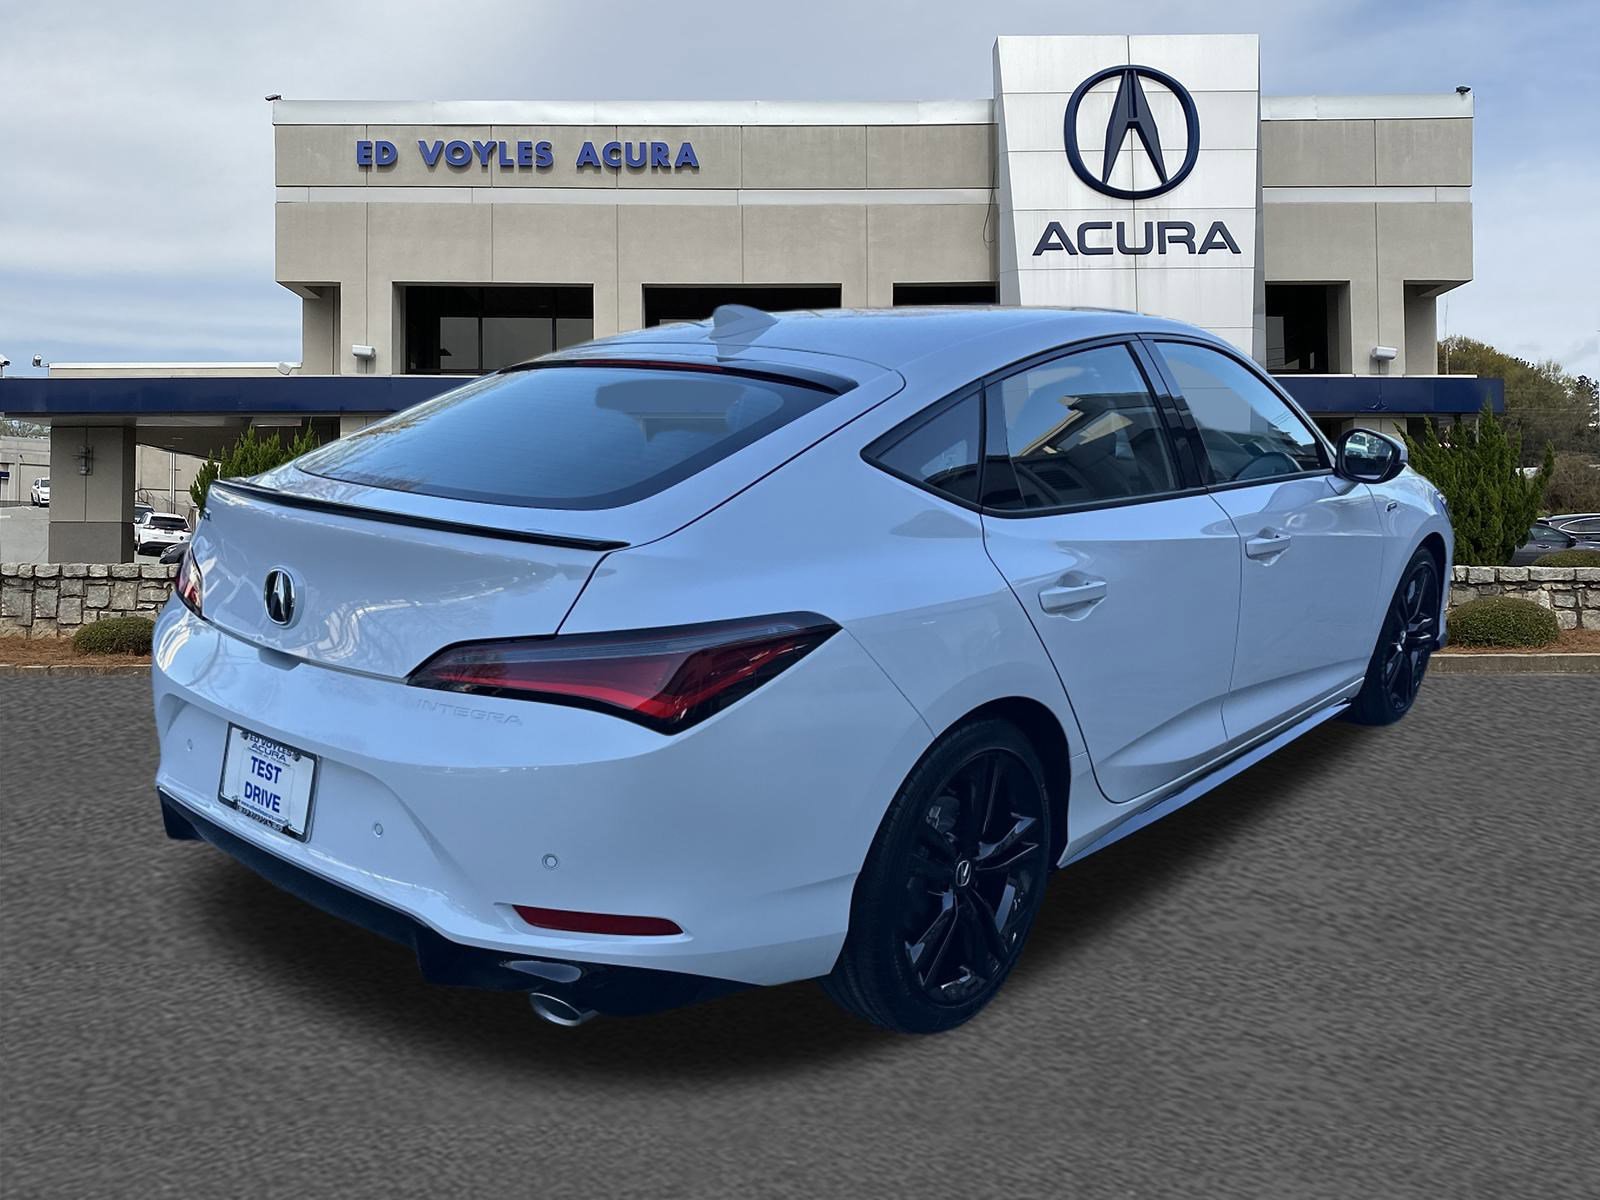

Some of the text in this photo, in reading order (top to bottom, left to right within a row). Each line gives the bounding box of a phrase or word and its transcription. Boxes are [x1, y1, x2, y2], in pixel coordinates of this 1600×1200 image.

[357, 140, 700, 169] ED VOYLES ACURA
[1032, 221, 1242, 256] ACURA
[416, 698, 522, 726] INTEGRA
[251, 742, 287, 762] ACURA
[251, 755, 282, 784] TEST
[244, 781, 281, 814] DRIVE
